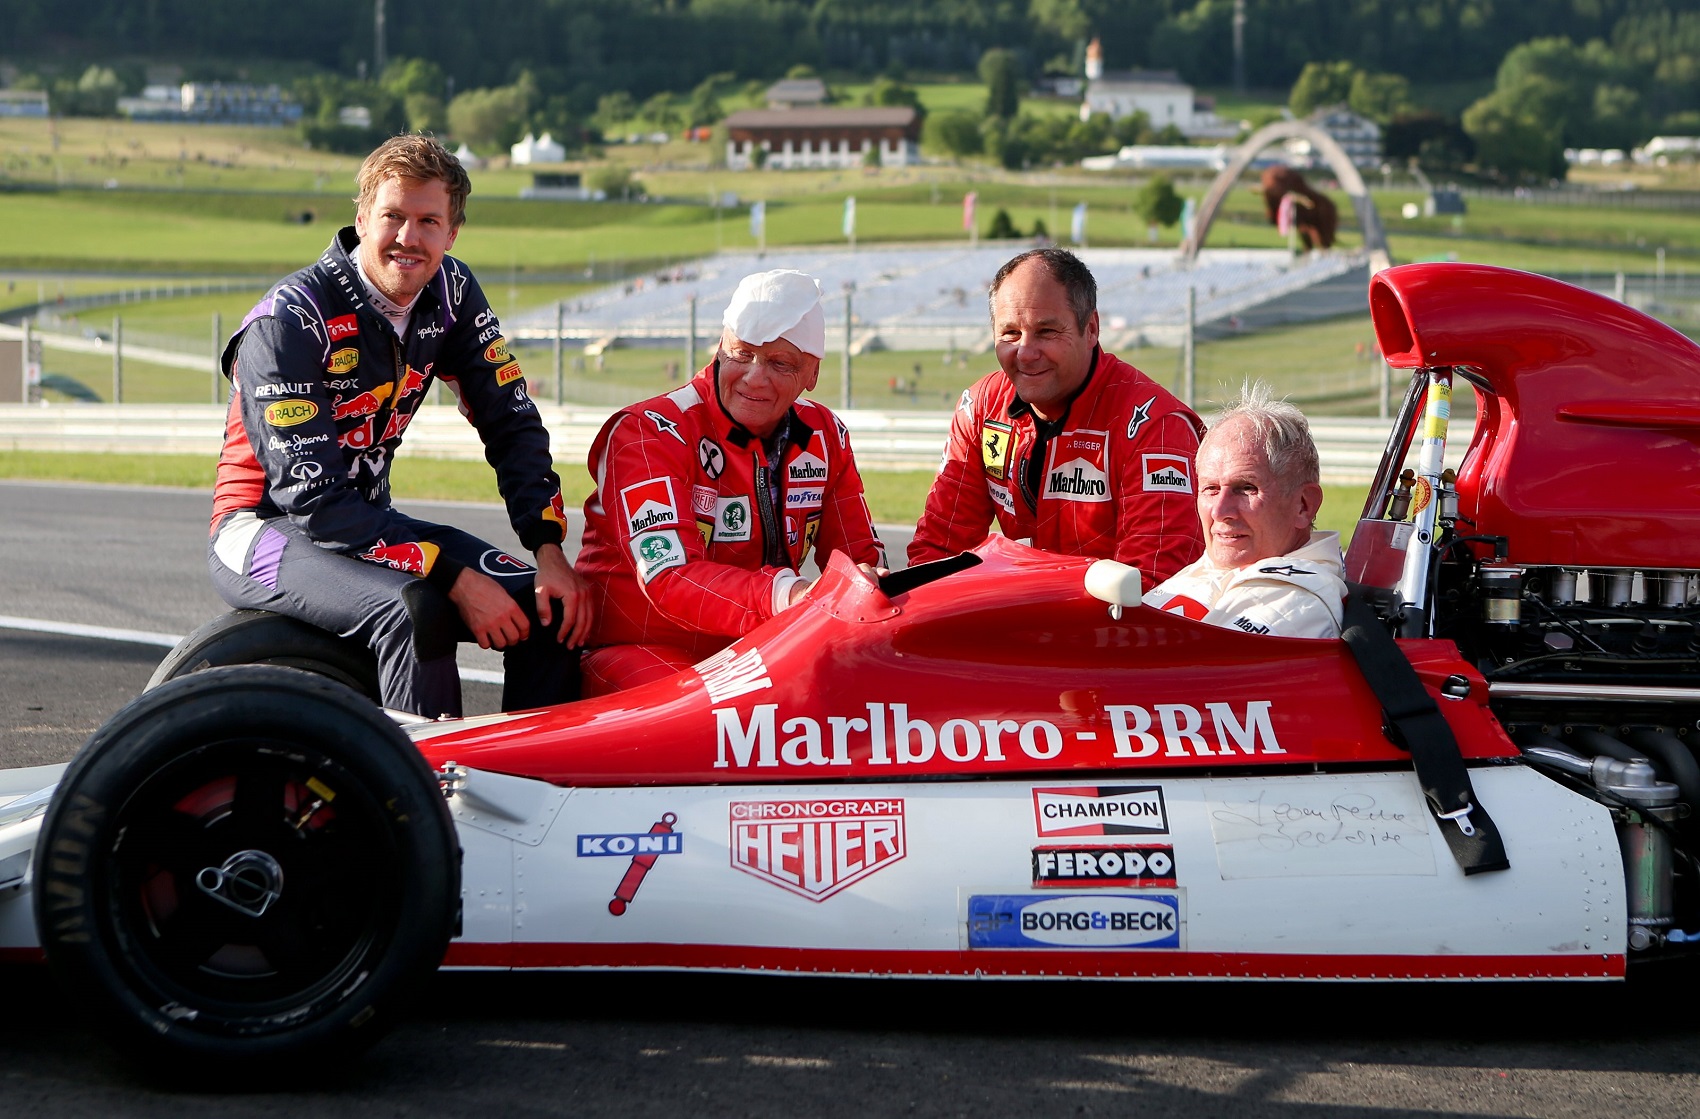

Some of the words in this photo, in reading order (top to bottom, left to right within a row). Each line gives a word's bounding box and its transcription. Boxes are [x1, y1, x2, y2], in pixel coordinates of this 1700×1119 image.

[255, 382, 314, 398] RENAULT
[275, 404, 312, 420] RAUCH
[269, 436, 293, 454] Pepe
[292, 434, 330, 451] Jeans
[1073, 440, 1101, 451] BERGER
[287, 451, 313, 459] LONDON
[789, 462, 826, 479] Marlboro
[1151, 471, 1187, 487] Marlboro
[1048, 467, 1106, 496] Marlboro
[631, 509, 674, 534] Marlboro
[712, 702, 1063, 768] Marlboro
[1104, 700, 1288, 758] BRM
[731, 800, 902, 819] CHRONOGRAPH
[1043, 801, 1159, 819] CHAMPION
[581, 835, 677, 854] KONI
[739, 820, 898, 895] HEUER
[1037, 851, 1173, 877] FERODO
[1022, 911, 1174, 931] BORG&BECK
